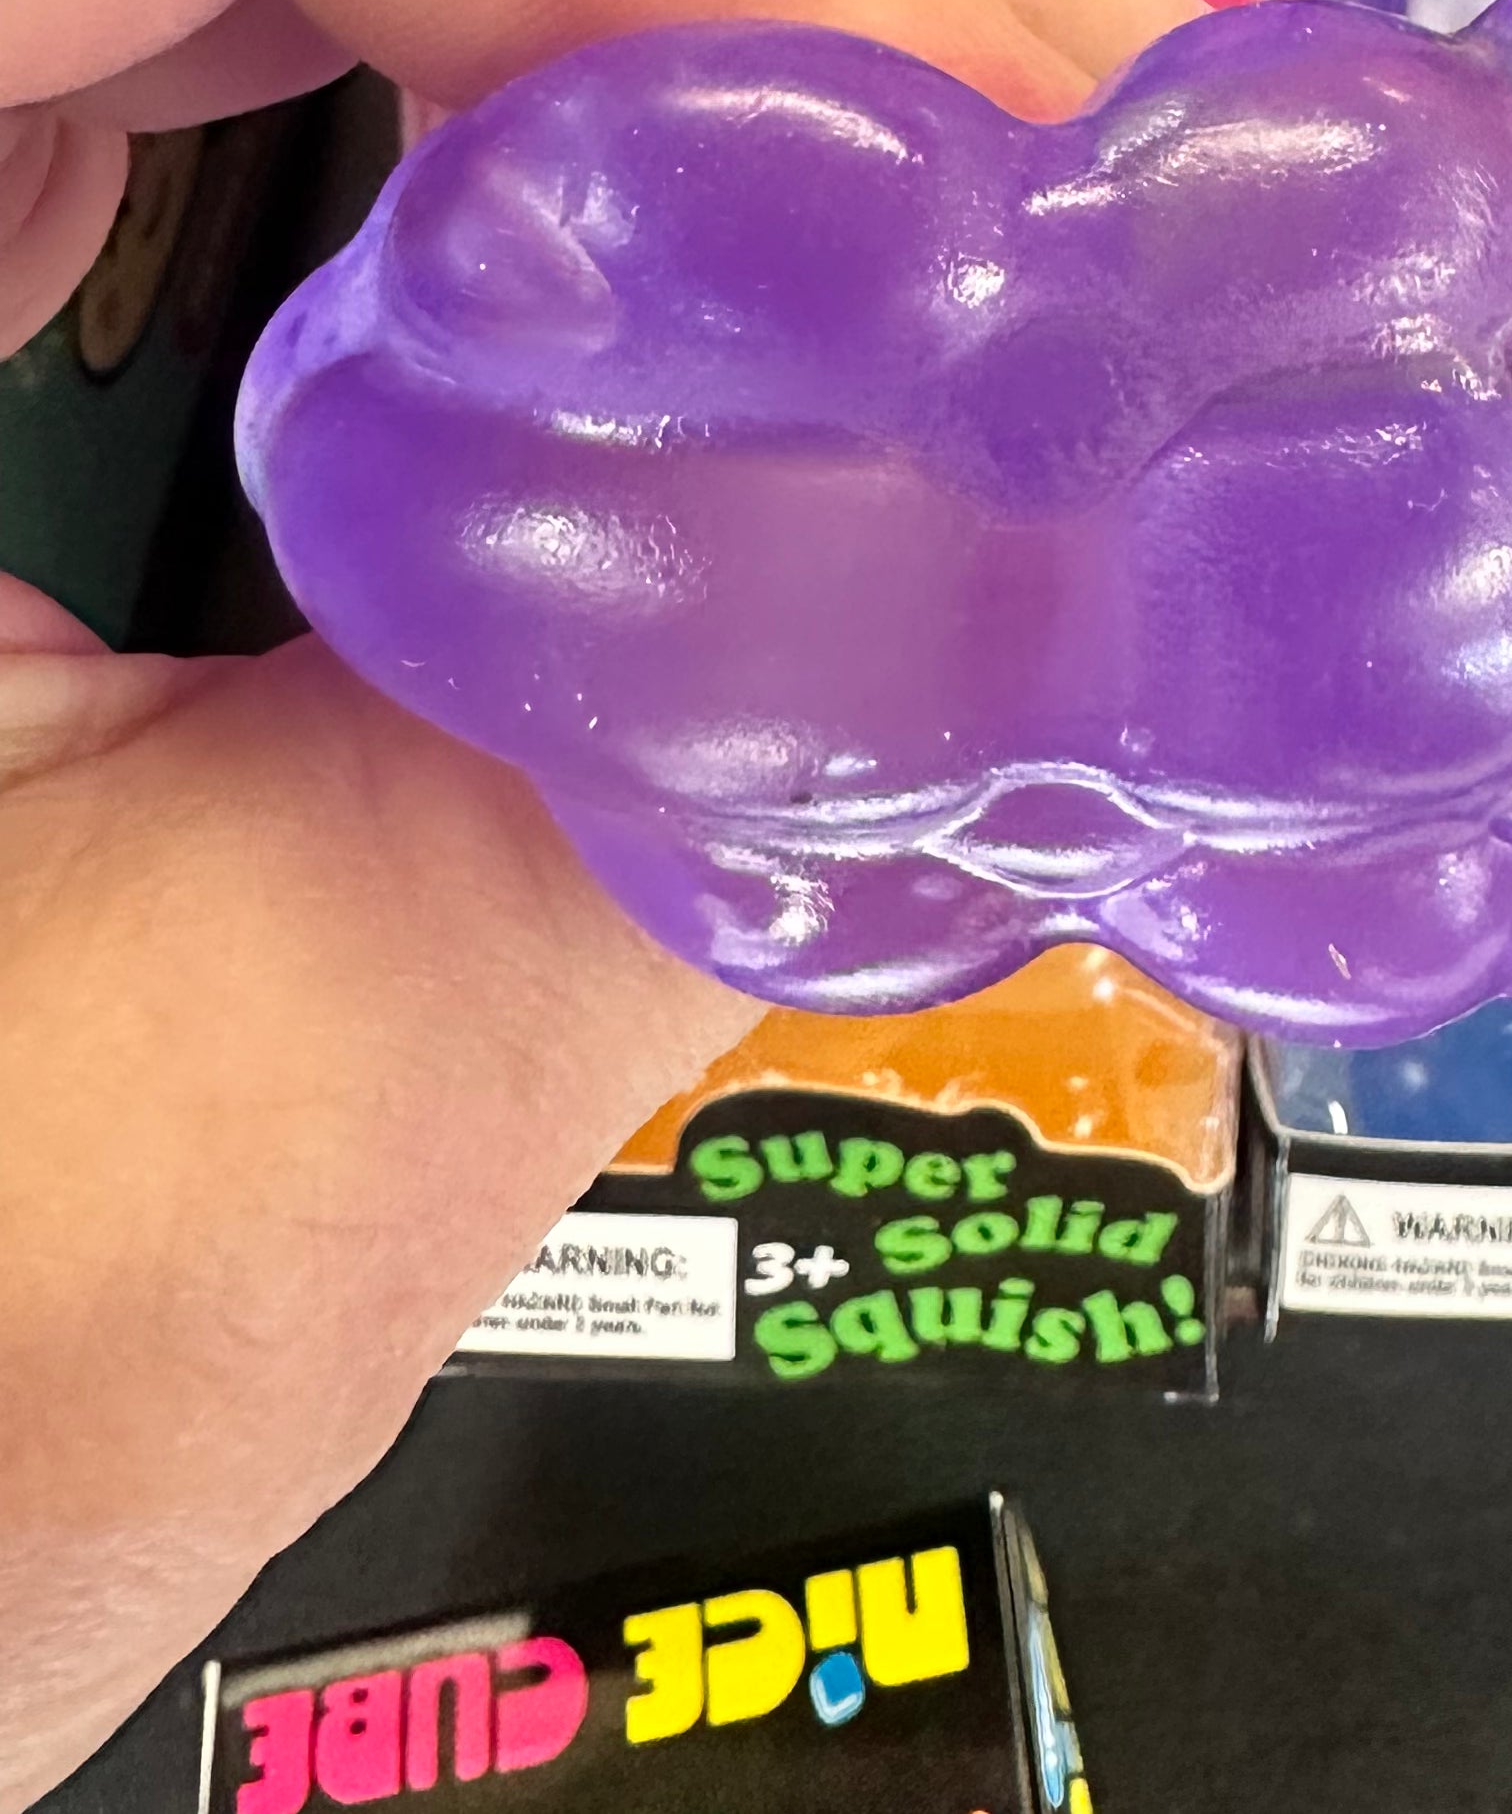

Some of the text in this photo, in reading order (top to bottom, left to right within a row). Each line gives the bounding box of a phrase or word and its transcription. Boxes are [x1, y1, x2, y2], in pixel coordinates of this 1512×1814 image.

[690, 1130, 1017, 1203] Super
[524, 1243, 688, 1279] ARNING:
[743, 1241, 851, 1298] 3+
[874, 1195, 1179, 1275] Solid
[752, 1273, 1208, 1382] Squish!
[235, 1635, 590, 1814] CUBE
